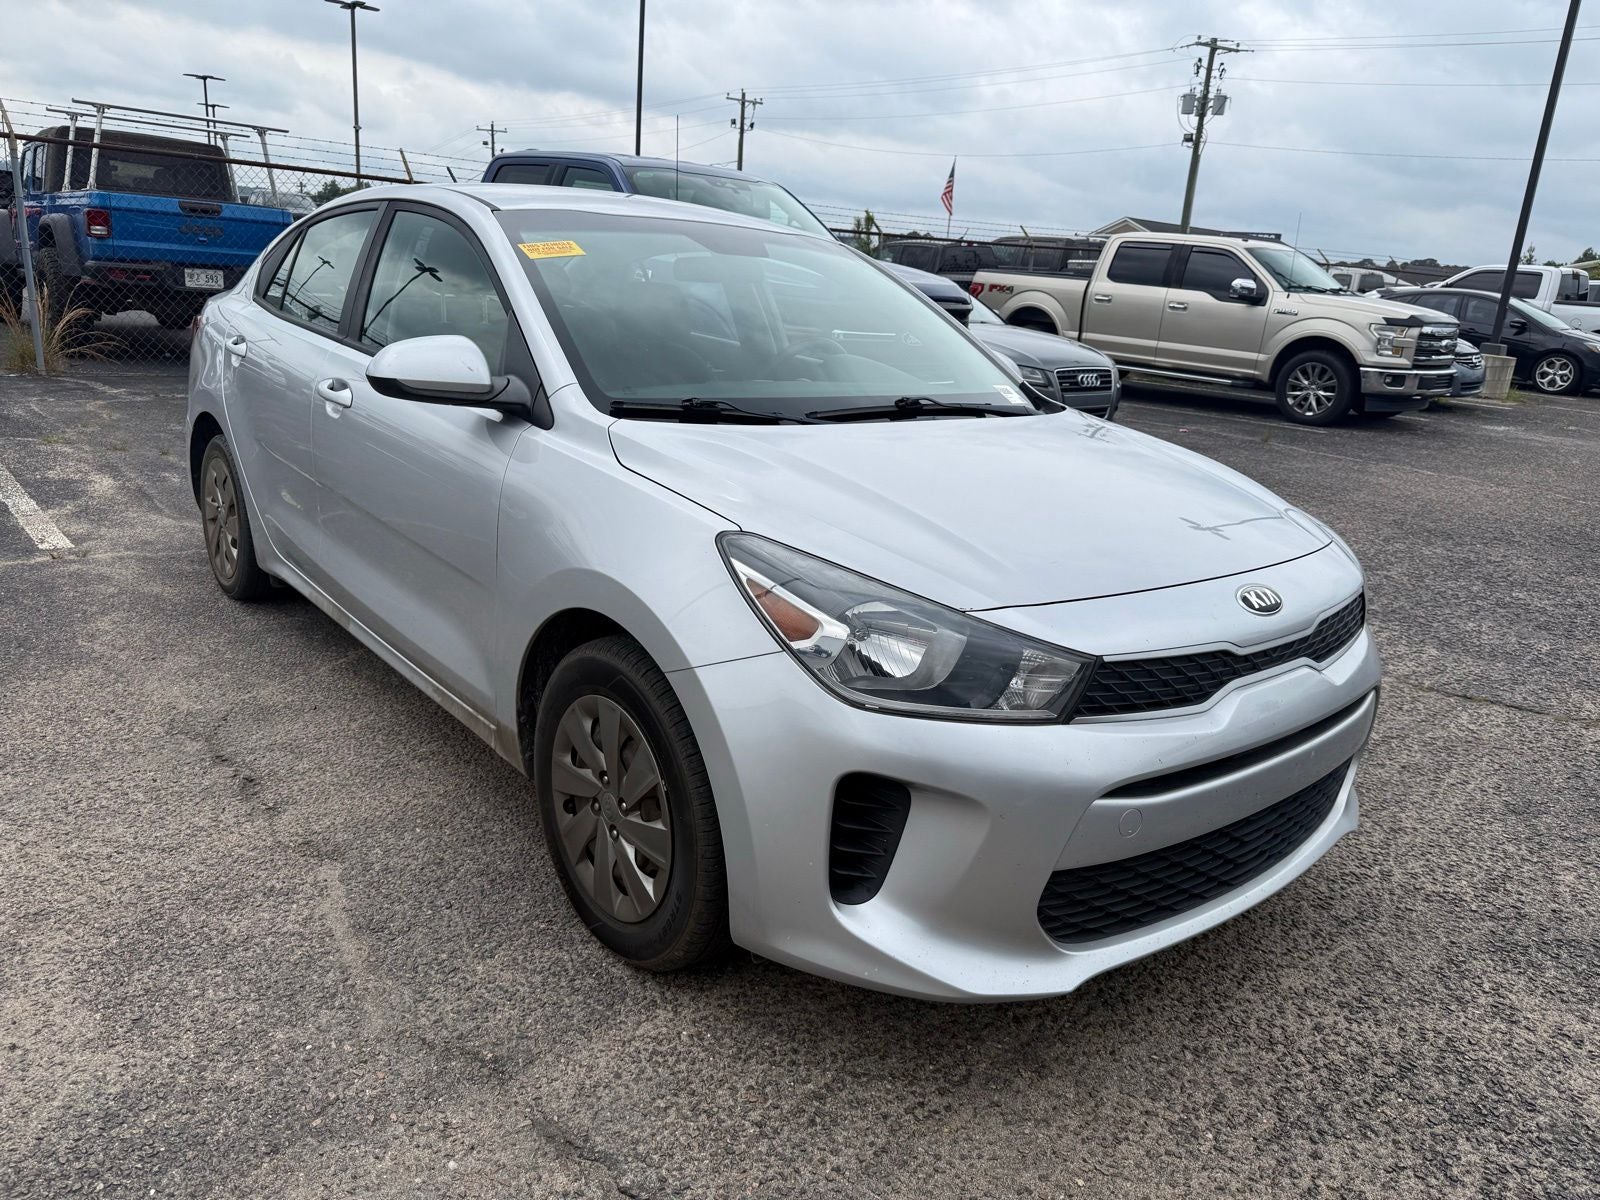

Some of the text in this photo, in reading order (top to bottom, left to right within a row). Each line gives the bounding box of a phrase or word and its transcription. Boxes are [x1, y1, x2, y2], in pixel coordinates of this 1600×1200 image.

[540, 240, 573, 248] VEHICLE
[988, 284, 1014, 295] FX4
[1242, 588, 1281, 609] KIA
